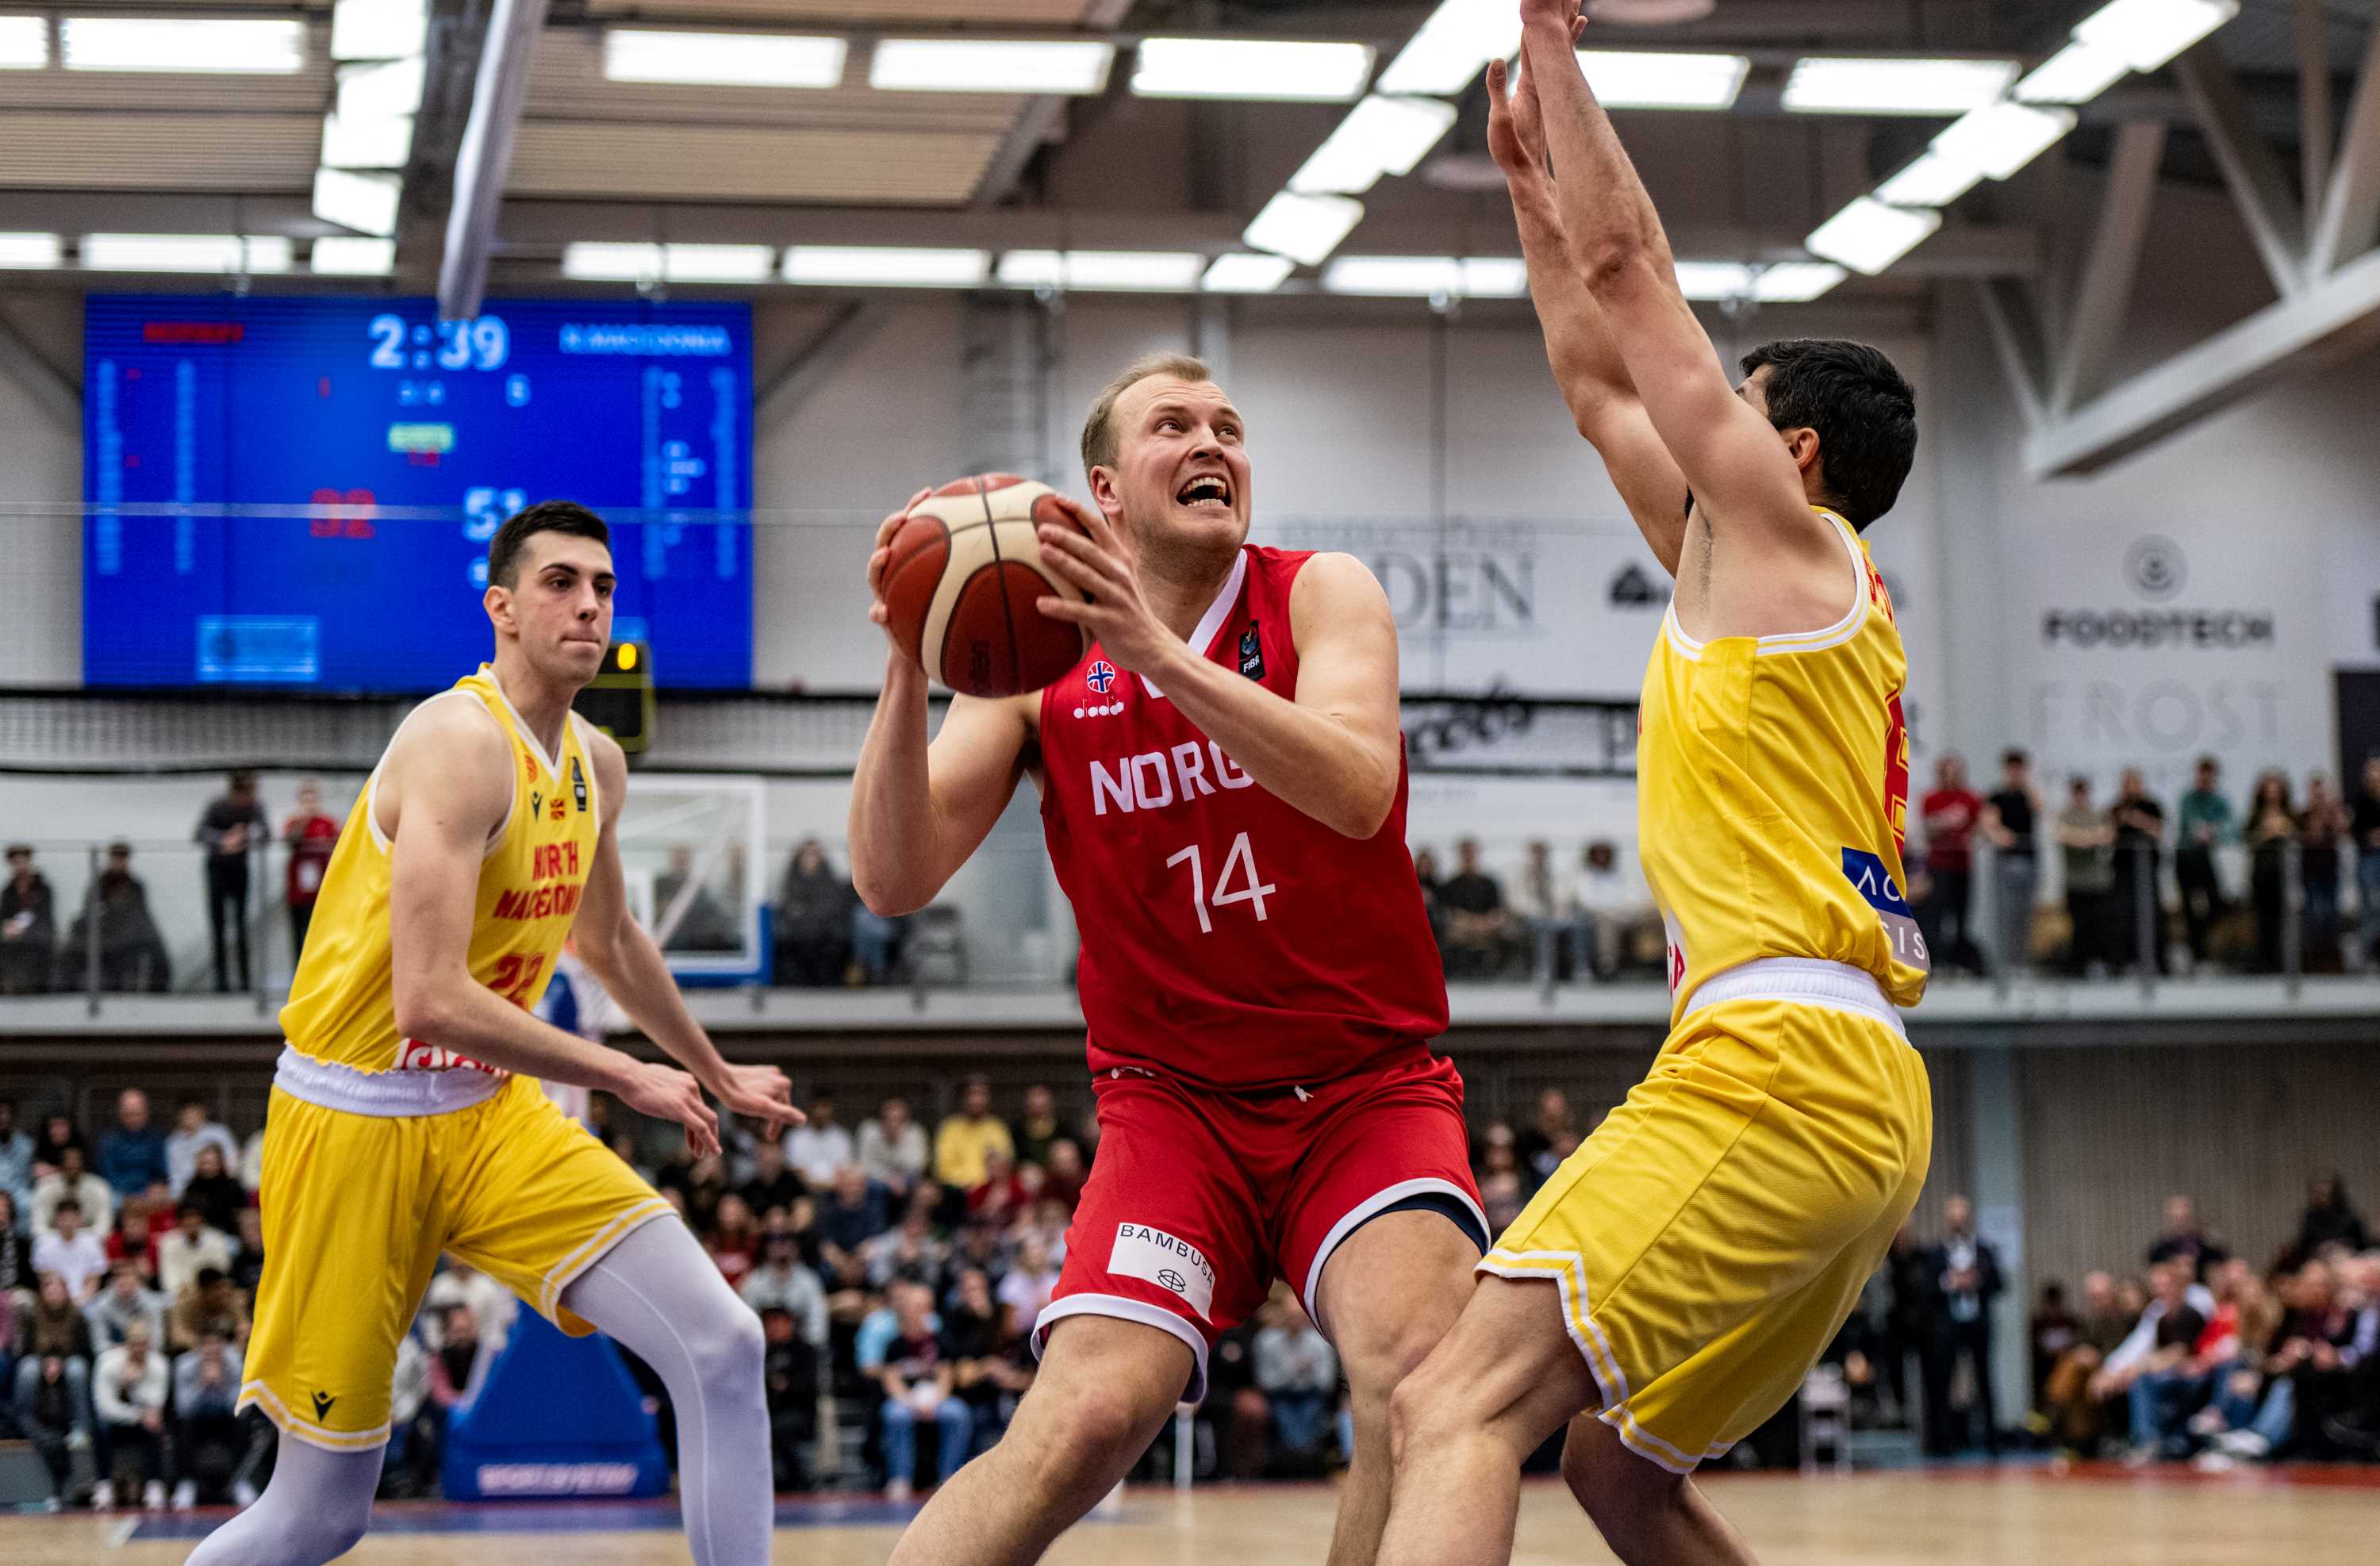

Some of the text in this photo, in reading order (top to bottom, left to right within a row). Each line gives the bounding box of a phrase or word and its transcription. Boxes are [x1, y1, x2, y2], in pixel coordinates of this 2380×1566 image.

[2042, 609, 2274, 649] FOODTECH
[1243, 654, 1260, 673] FIBA
[2029, 679, 2286, 750] FROST
[1089, 740, 1255, 816] NORG
[532, 840, 578, 882] NORTH
[493, 884, 584, 920] MACEDONI
[1120, 1224, 1213, 1289] BAMBUSA
